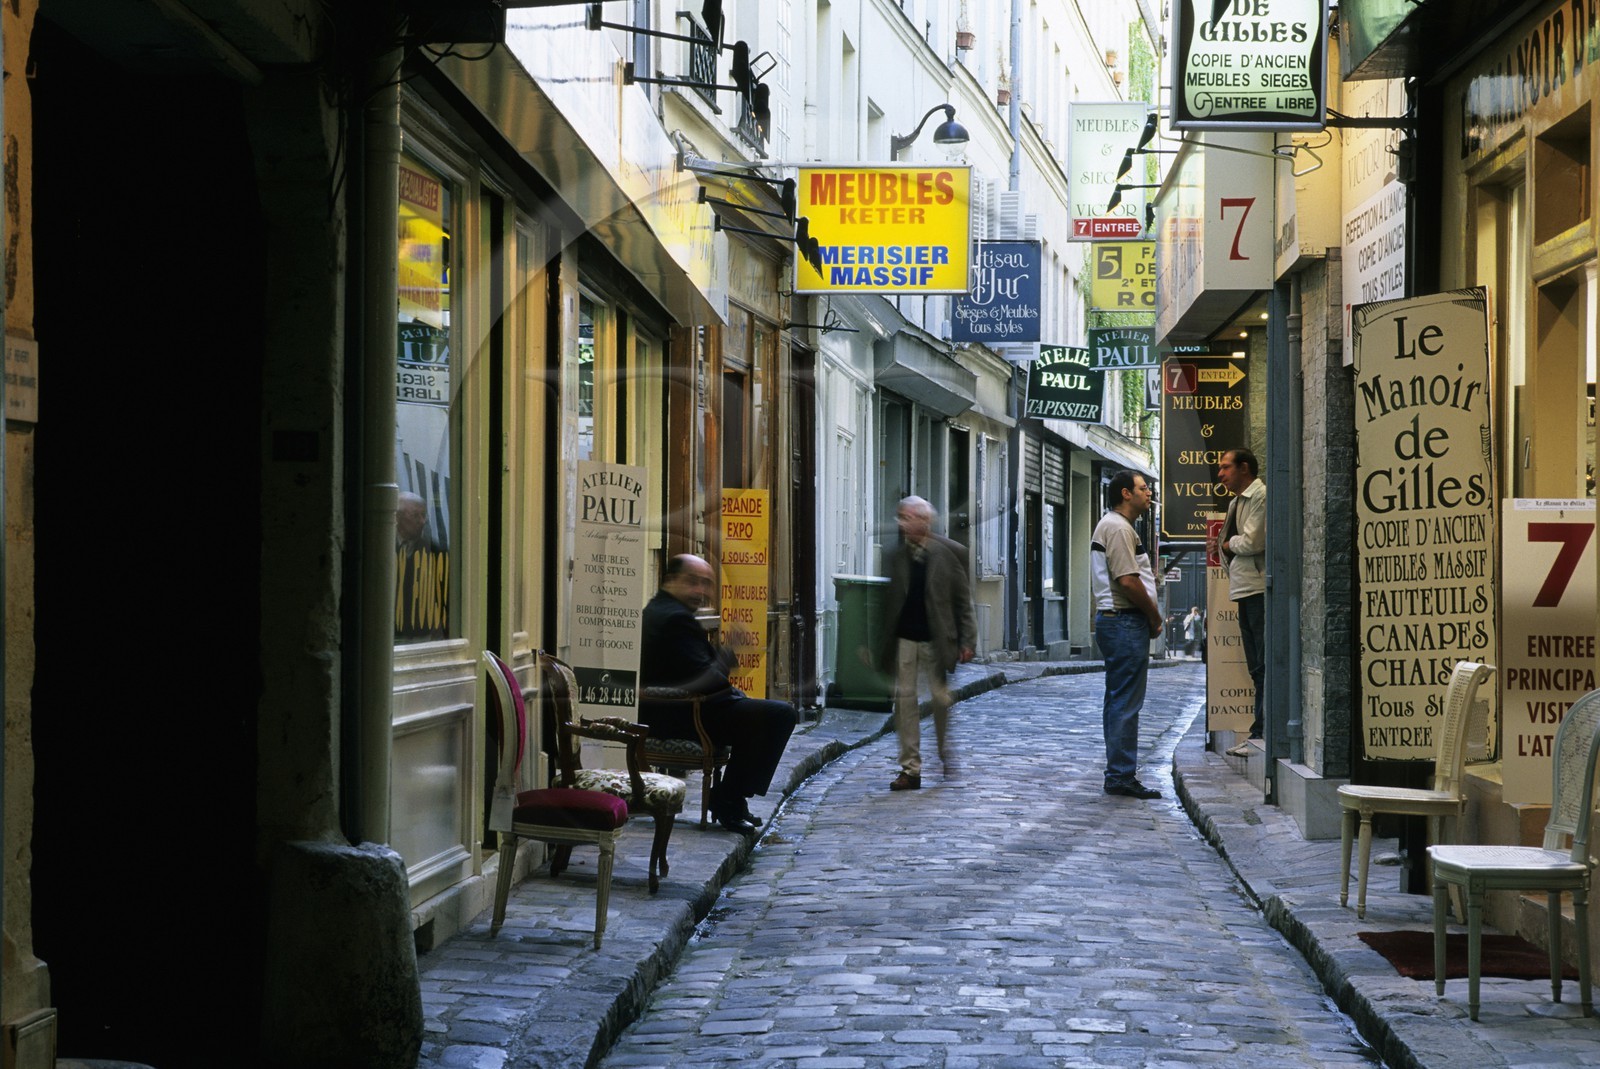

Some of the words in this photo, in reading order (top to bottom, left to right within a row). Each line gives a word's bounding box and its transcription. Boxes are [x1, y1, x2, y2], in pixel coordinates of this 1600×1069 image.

[1232, 0, 1270, 16] DE
[1200, 20, 1308, 43] GILLES
[1191, 53, 1232, 67] COPIE
[1241, 54, 1306, 69] D'ANCIEN
[1187, 72, 1250, 87] MEUBLES
[1261, 73, 1308, 88] SIEGES
[1215, 96, 1266, 109] ENTREE
[1277, 97, 1314, 110] LIBRE
[1076, 119, 1139, 132] MEUBLES
[1102, 143, 1112, 156] &
[1347, 138, 1380, 190] VICTOR
[1080, 171, 1133, 185] SIEGS
[810, 171, 954, 206] MEUBLES
[840, 207, 925, 225] KETER
[1077, 203, 1137, 217] VICOR
[1078, 222, 1088, 234] 7
[1094, 223, 1140, 232] ENTREE
[1220, 197, 1256, 260] 7
[1346, 205, 1378, 246] REFECTION
[819, 246, 949, 265] MERISIER
[1100, 251, 1120, 277] 5
[1358, 241, 1377, 273] COPIE
[830, 266, 934, 286] MASSIF
[1361, 278, 1378, 303] TOUS
[1379, 262, 1403, 295] STYLES
[997, 304, 1038, 321] Meubles
[970, 320, 992, 333] tous
[993, 320, 1023, 337] styles
[1097, 330, 1150, 346] ATELIER
[1393, 316, 1444, 360] Le
[1035, 348, 1090, 371] ATELIE
[1097, 346, 1157, 367] PAUL
[1040, 371, 1091, 391] PAUL
[1170, 368, 1183, 389] 7
[1201, 371, 1238, 381] ENTREE
[1172, 395, 1243, 410] MEUBLES
[1358, 363, 1481, 423] Manoir
[1027, 399, 1099, 419] TAPISSIER
[1200, 423, 1214, 438] &
[1394, 413, 1449, 461] de
[582, 471, 642, 498] ATELIER
[1363, 462, 1486, 514] Gilles
[581, 494, 642, 526] PAUL
[727, 522, 753, 538] EXPO
[1364, 519, 1409, 549] COPIE
[1416, 513, 1486, 546] D'ANCIEN
[584, 564, 605, 574] TOUS
[607, 566, 636, 576] STYLES
[591, 554, 629, 566] MEUBLES
[1365, 553, 1427, 583] MEUBLES
[1434, 549, 1487, 580] MASSIF
[1528, 522, 1596, 608] 7
[590, 585, 628, 596] CANAPES
[734, 585, 767, 600] MEUBLES
[1366, 584, 1488, 617] FAUTEUILS
[576, 604, 640, 618] BIBLIOTHEQUES
[722, 608, 753, 623] CHAISES
[579, 616, 636, 629] COMPOSABLES
[579, 637, 593, 647] LIT
[595, 639, 633, 650] GIGOGNE
[1367, 620, 1489, 653] CANAPES
[1528, 635, 1595, 658] ENTREE
[1367, 656, 1489, 688] CHAIS
[585, 686, 596, 702] 46
[599, 687, 609, 703] 28
[612, 687, 622, 704] 44
[624, 688, 634, 705] 83
[1220, 688, 1255, 698] COPIE
[1368, 694, 1414, 718] Tous
[1369, 726, 1432, 748] ENTREE
